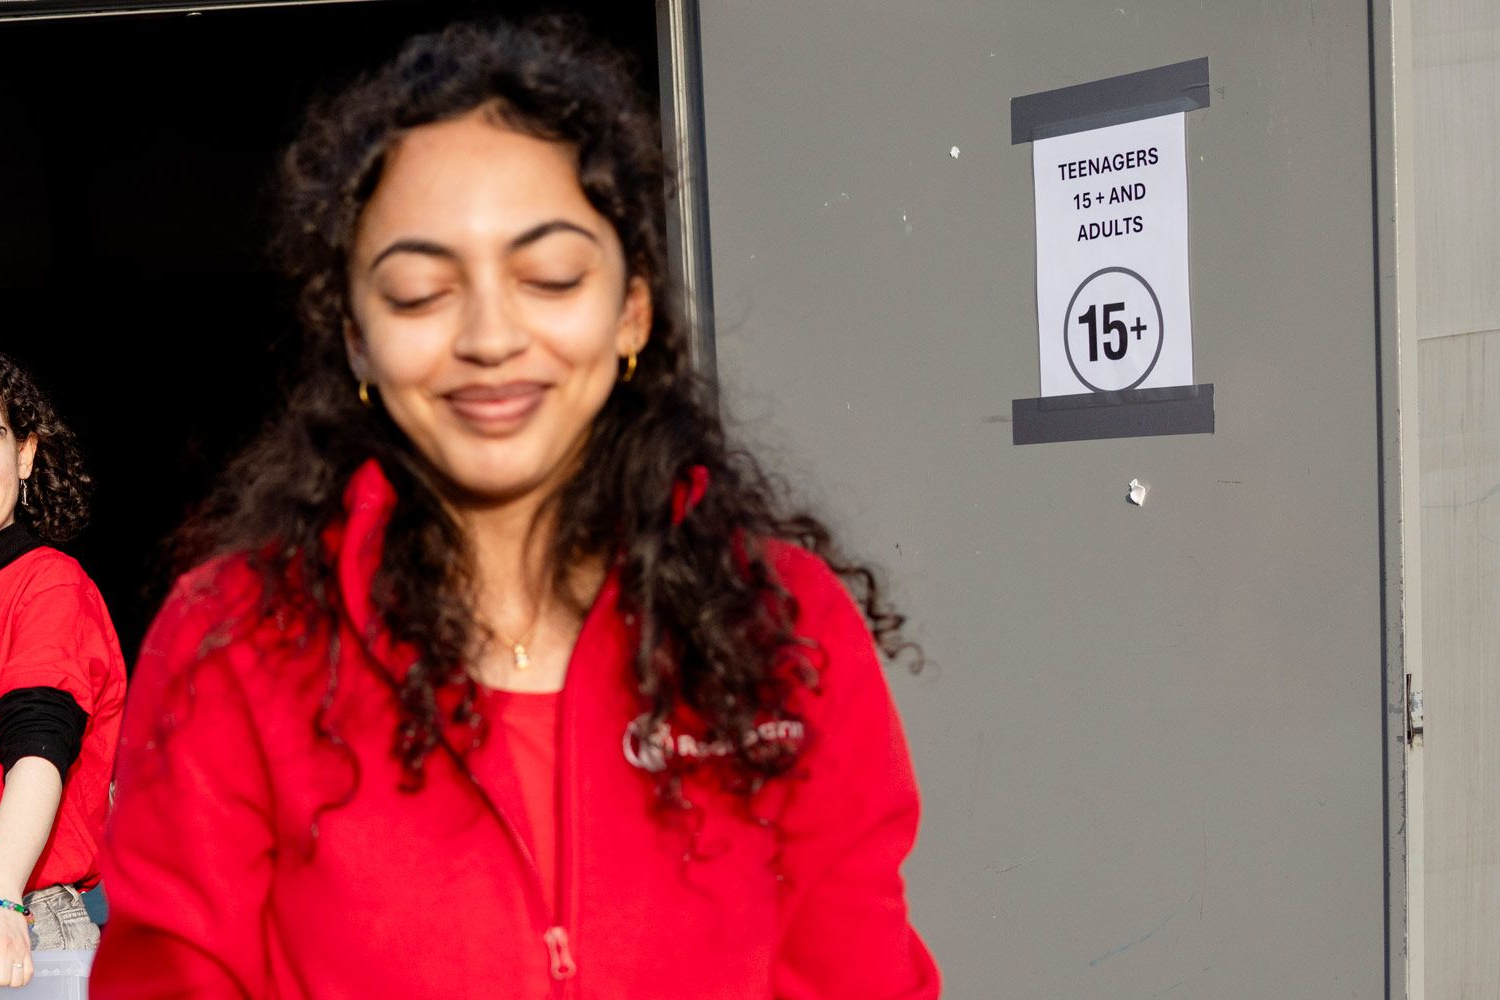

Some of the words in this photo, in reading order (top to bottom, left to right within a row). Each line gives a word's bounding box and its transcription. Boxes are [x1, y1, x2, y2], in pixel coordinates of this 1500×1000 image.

[1057, 146, 1160, 181] TEENAGERS
[1108, 182, 1147, 207] AND
[1076, 215, 1144, 242] ADULTS
[1077, 301, 1148, 363] 15+
